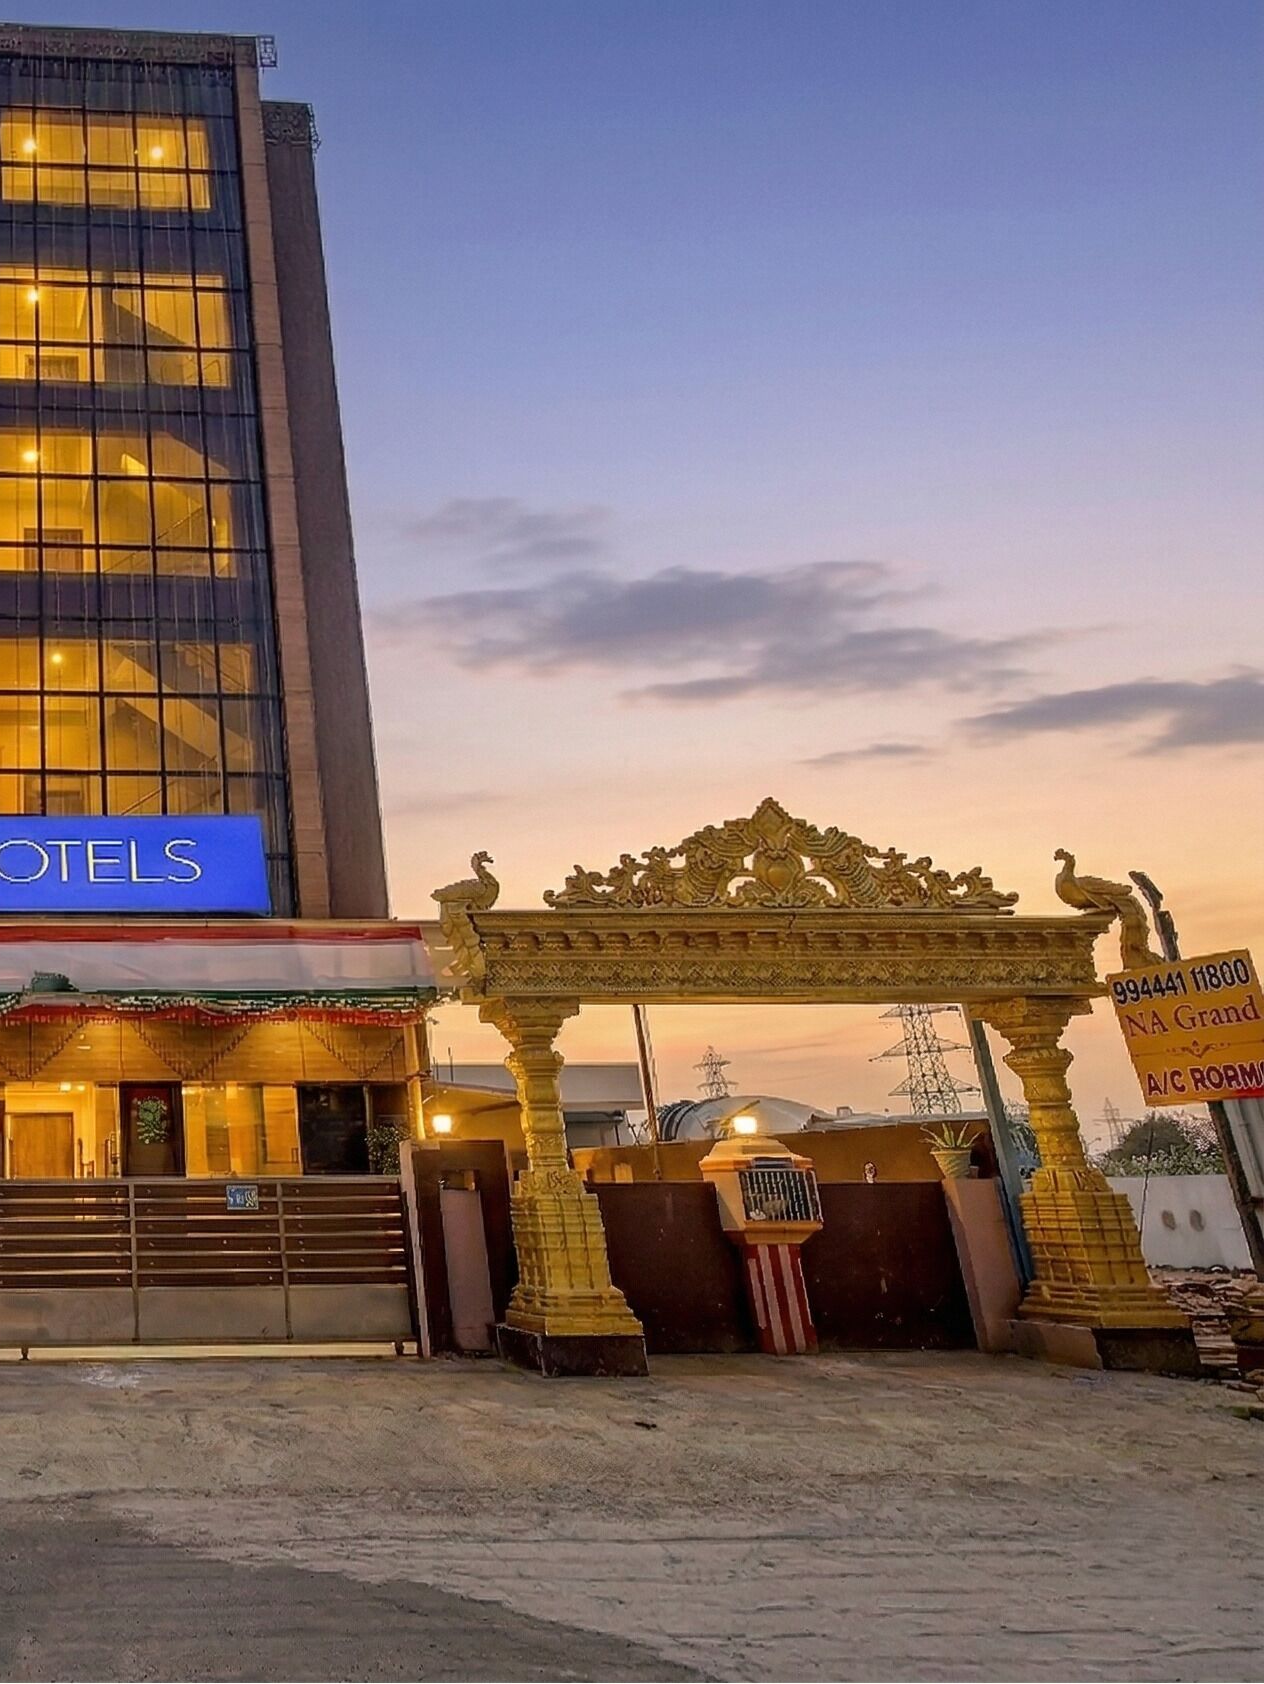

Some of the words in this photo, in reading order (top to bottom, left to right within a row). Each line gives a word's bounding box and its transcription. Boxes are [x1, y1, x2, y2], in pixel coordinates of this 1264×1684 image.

[1113, 970, 1187, 1005] 994441
[1190, 958, 1250, 992] 11800
[1125, 1010, 1169, 1037] NA
[1174, 995, 1261, 1030] Grand
[1146, 1068, 1186, 1097] A/C
[1189, 1061, 1264, 1091] RORM
